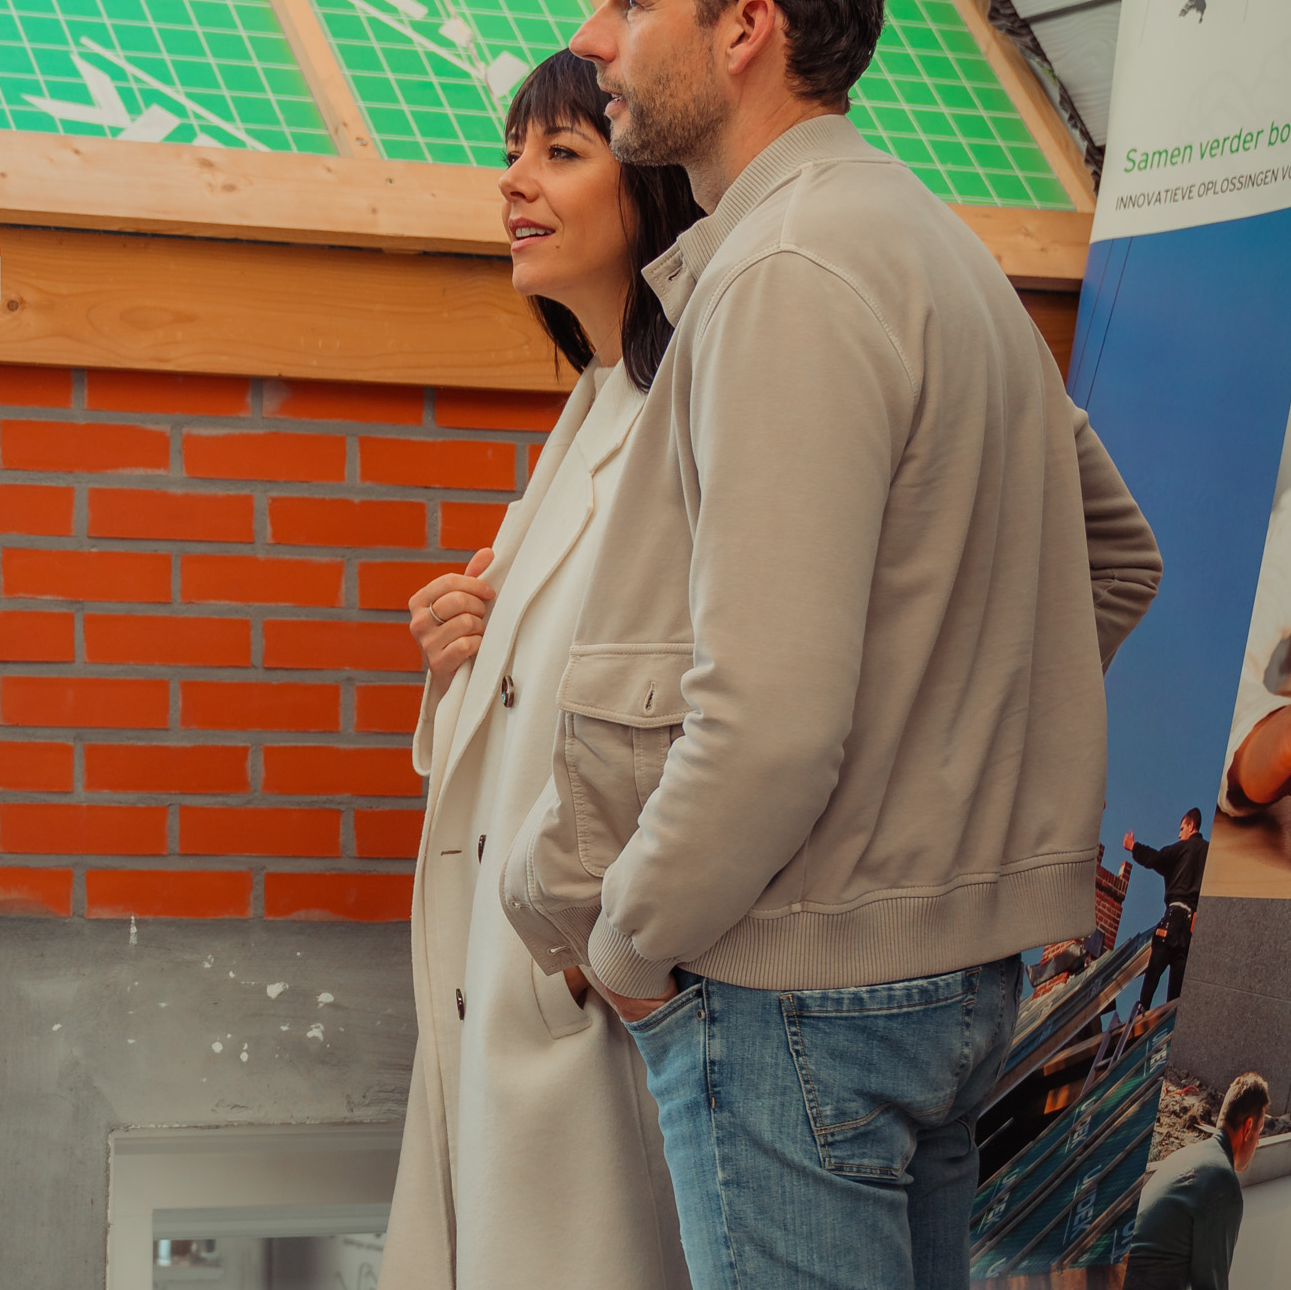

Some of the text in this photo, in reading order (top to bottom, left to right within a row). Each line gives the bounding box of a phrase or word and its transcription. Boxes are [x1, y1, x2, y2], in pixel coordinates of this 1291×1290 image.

[1123, 143, 1193, 174] Samen
[1199, 127, 1265, 161] verder
[1115, 183, 1197, 211] INNOVATIEVE
[1197, 167, 1280, 199] OPLOSSINGEN
